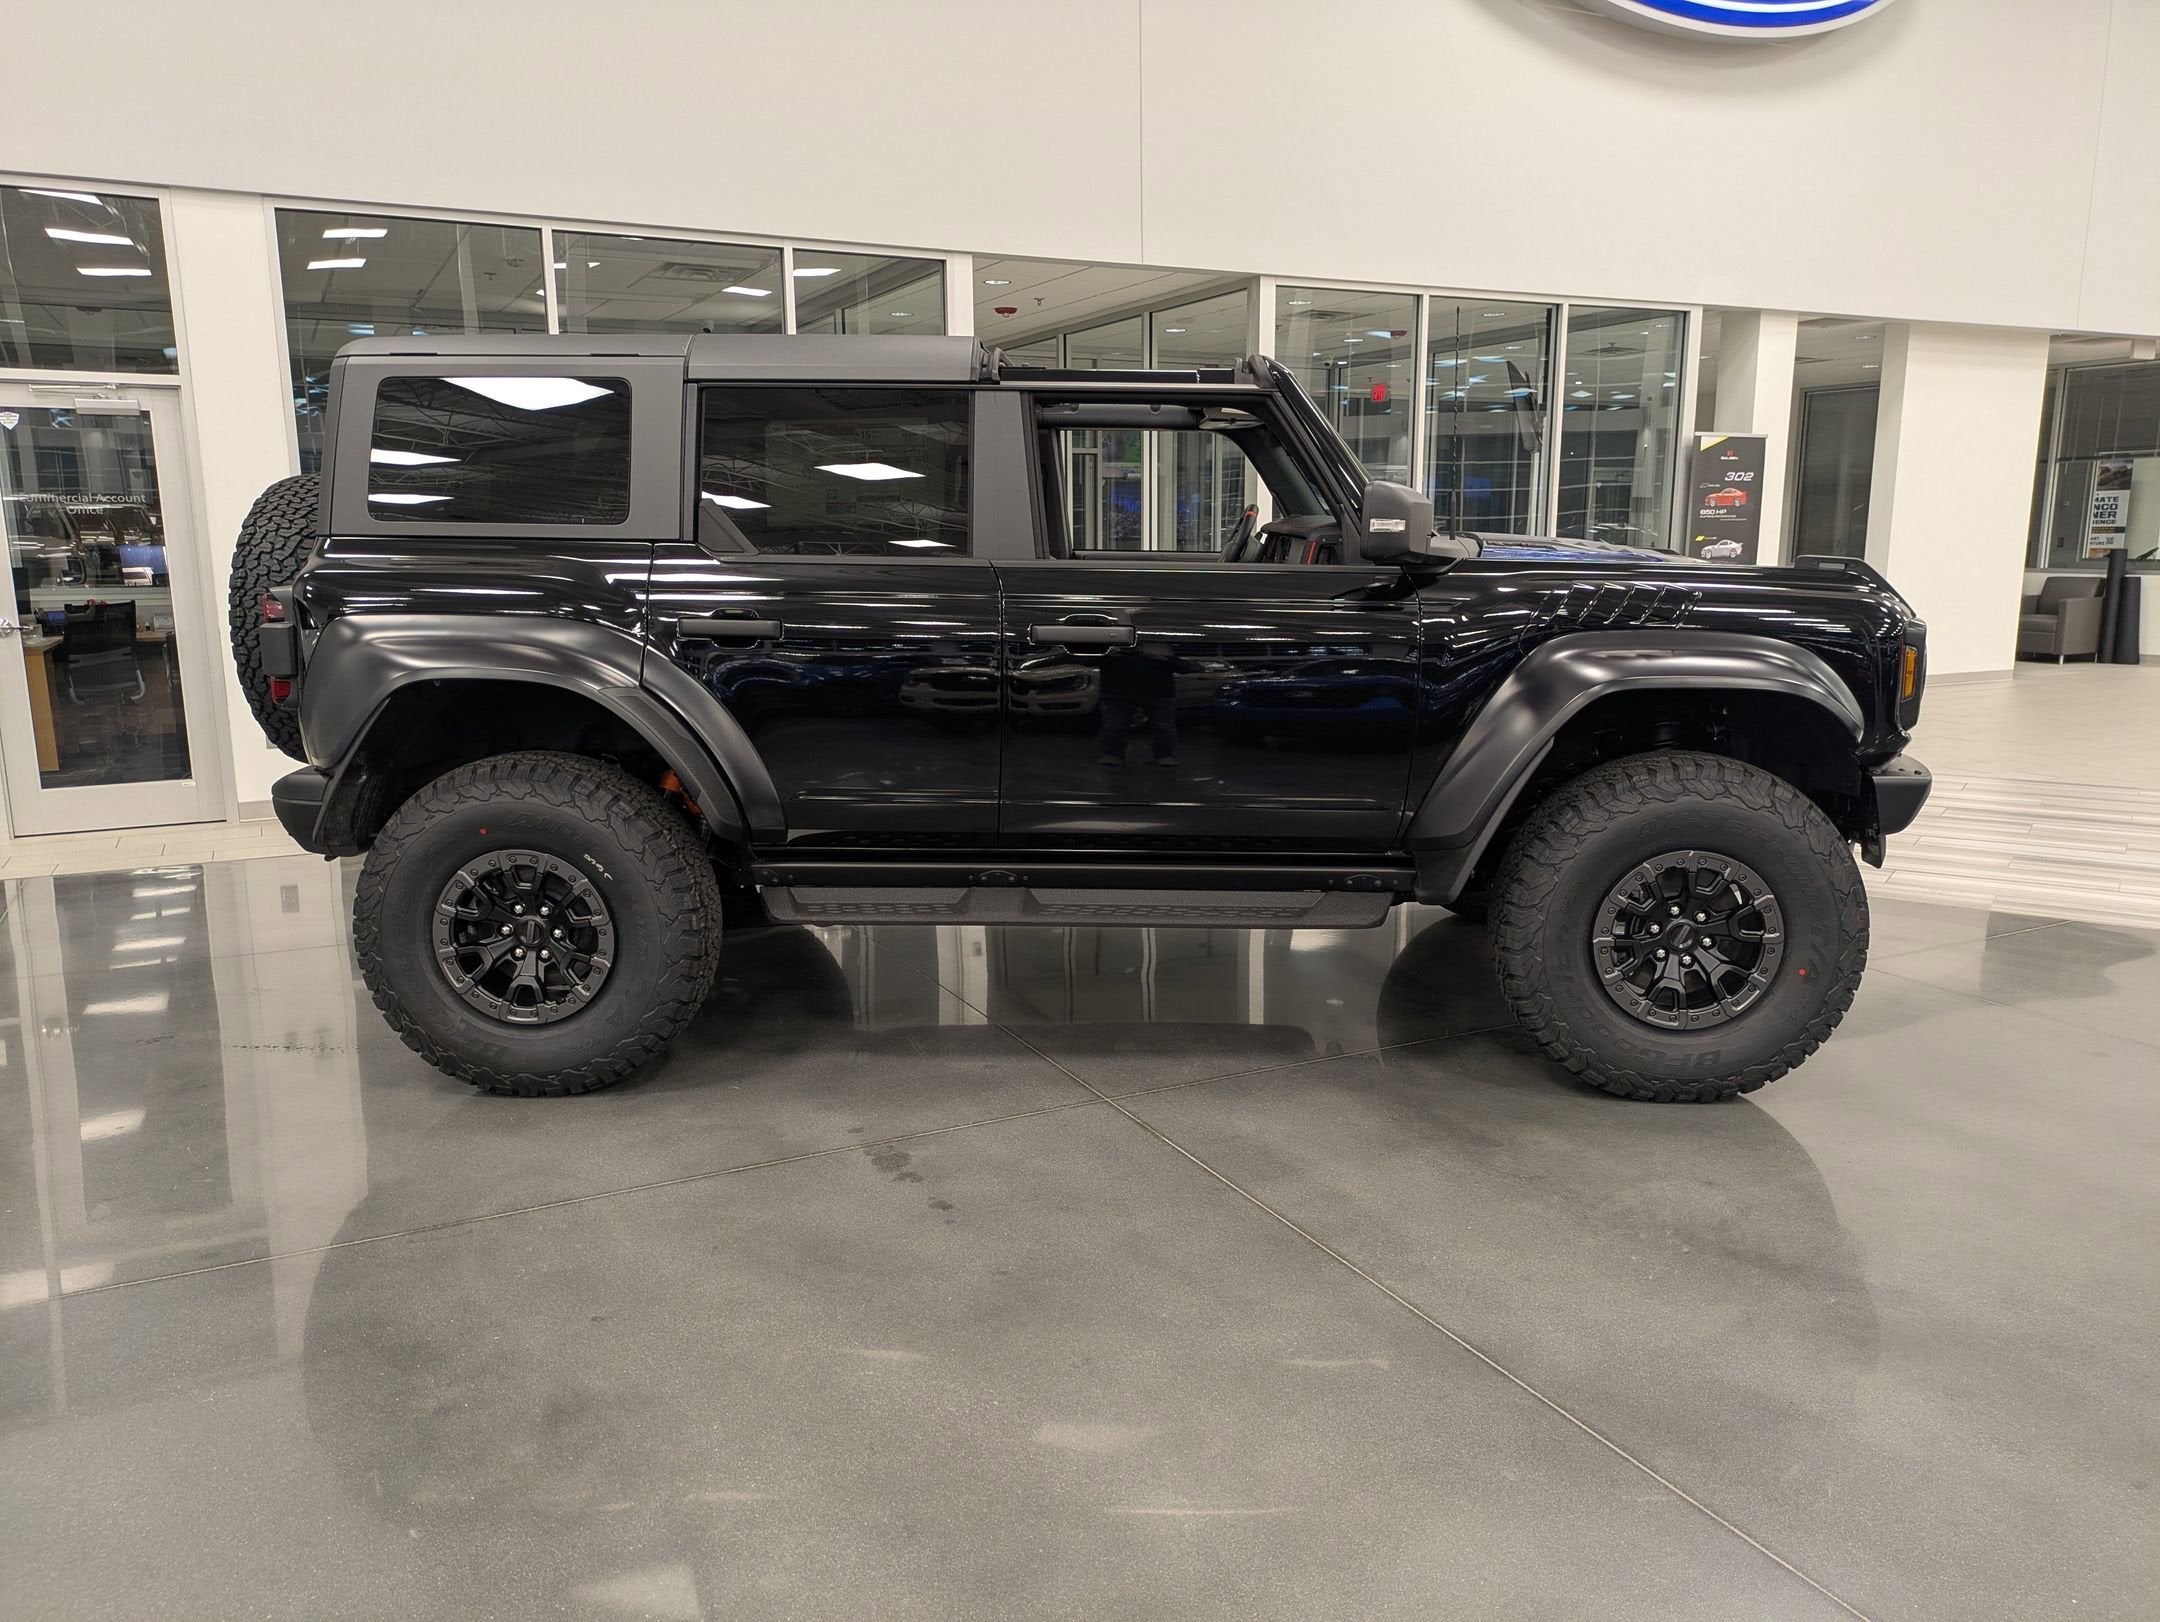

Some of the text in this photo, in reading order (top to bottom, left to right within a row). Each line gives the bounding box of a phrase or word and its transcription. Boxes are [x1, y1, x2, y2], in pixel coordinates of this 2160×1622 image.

[1725, 472, 1754, 481] 302
[19, 492, 147, 503] ommercial Account
[2094, 503, 2118, 511] NCO
[2093, 511, 2117, 519] NER
